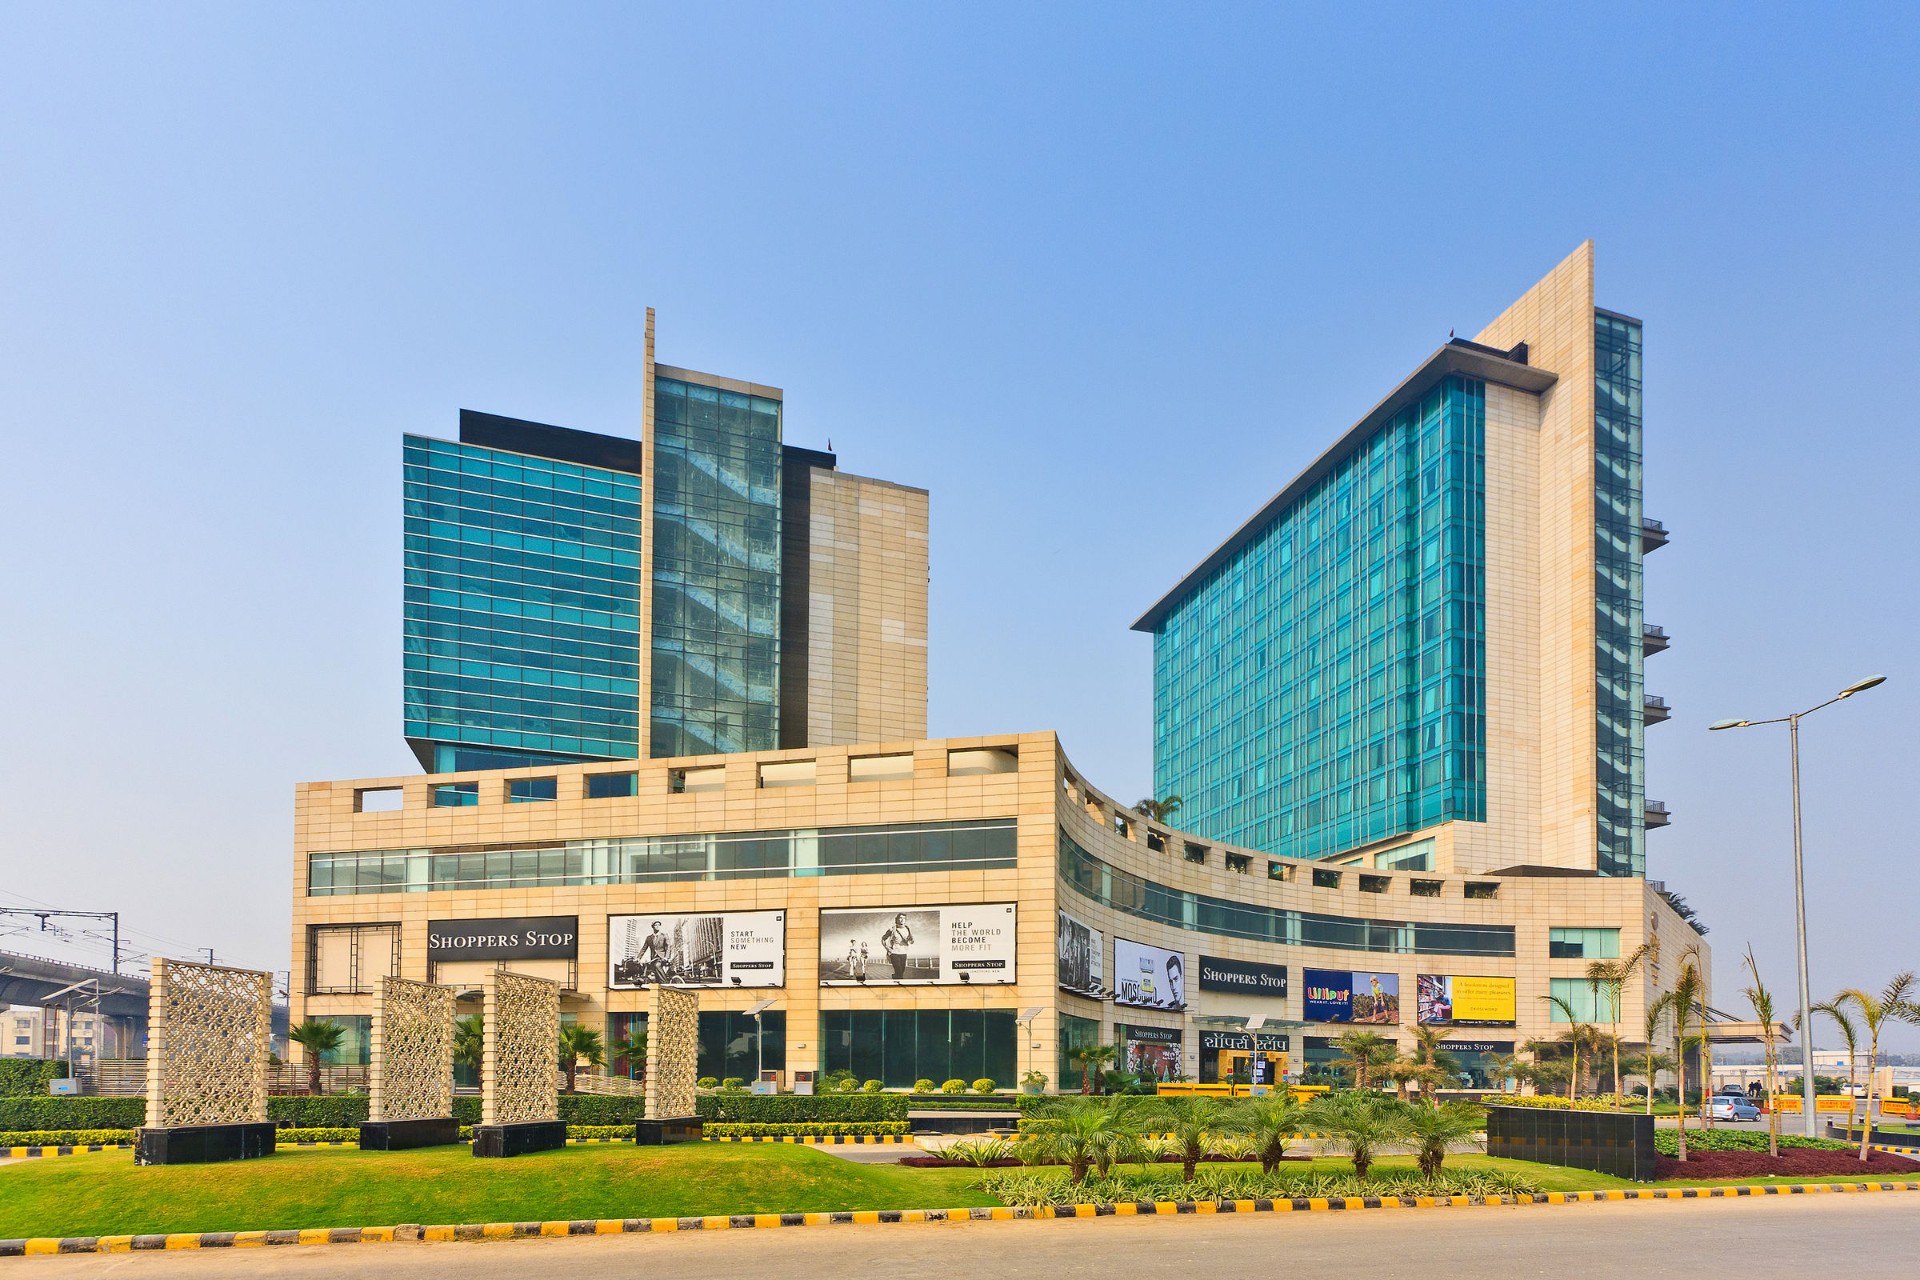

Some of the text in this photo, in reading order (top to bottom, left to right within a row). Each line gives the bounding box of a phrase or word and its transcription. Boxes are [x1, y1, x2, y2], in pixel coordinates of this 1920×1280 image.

[429, 930, 574, 949] SHOPPERS STOP
[951, 936, 986, 944] BECOME
[1203, 967, 1287, 988] SHOPPERS STOP
[1134, 1029, 1173, 1040] SHOPPERS STOP
[1435, 1042, 1494, 1051] SHOPPERS STOP
